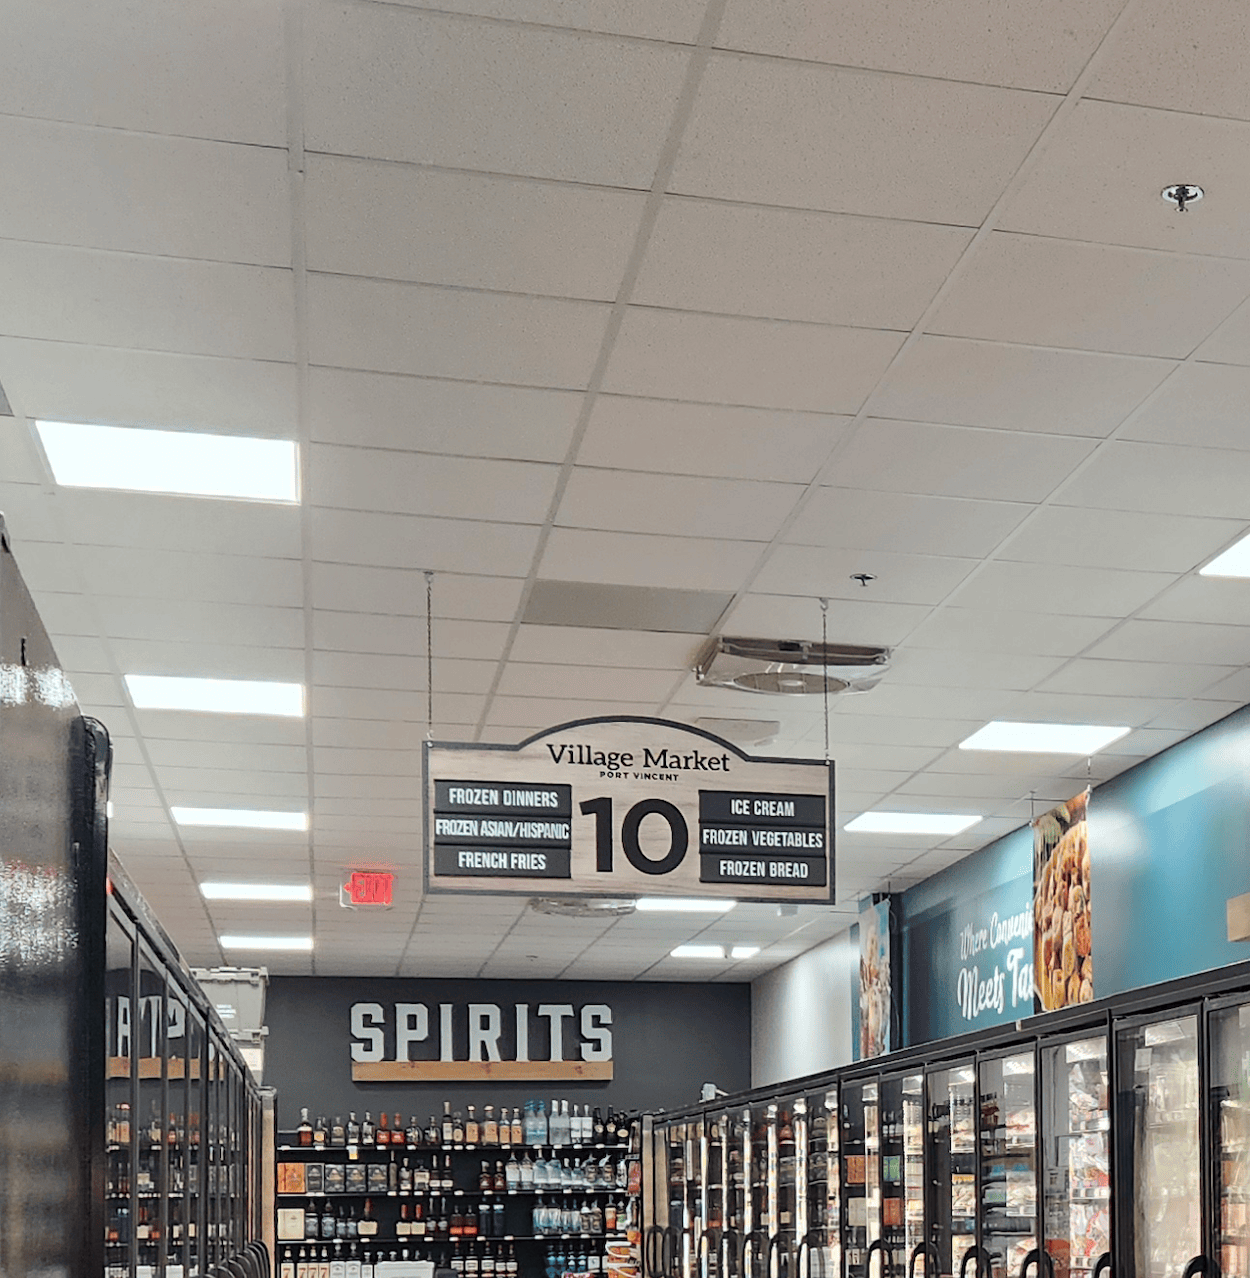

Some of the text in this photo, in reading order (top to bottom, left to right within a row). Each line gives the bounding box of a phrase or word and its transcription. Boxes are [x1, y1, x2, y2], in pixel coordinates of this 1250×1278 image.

[546, 744, 730, 771] Village Market
[600, 771, 679, 781] PORT VINCENT
[449, 788, 558, 808] FROZEN DINNERS
[731, 799, 795, 816] ICE CREAM
[435, 819, 569, 839] FROZEN ASIAN/HISPANIC
[579, 797, 689, 875] 10
[703, 829, 823, 848] FROZEN VEGETABLES
[458, 852, 546, 870] FRENCH FRIES
[720, 860, 808, 878] FROZEN BREAD
[960, 922, 987, 960] Where
[957, 965, 1006, 1021] Meets
[350, 1002, 613, 1062] SPIRITS
